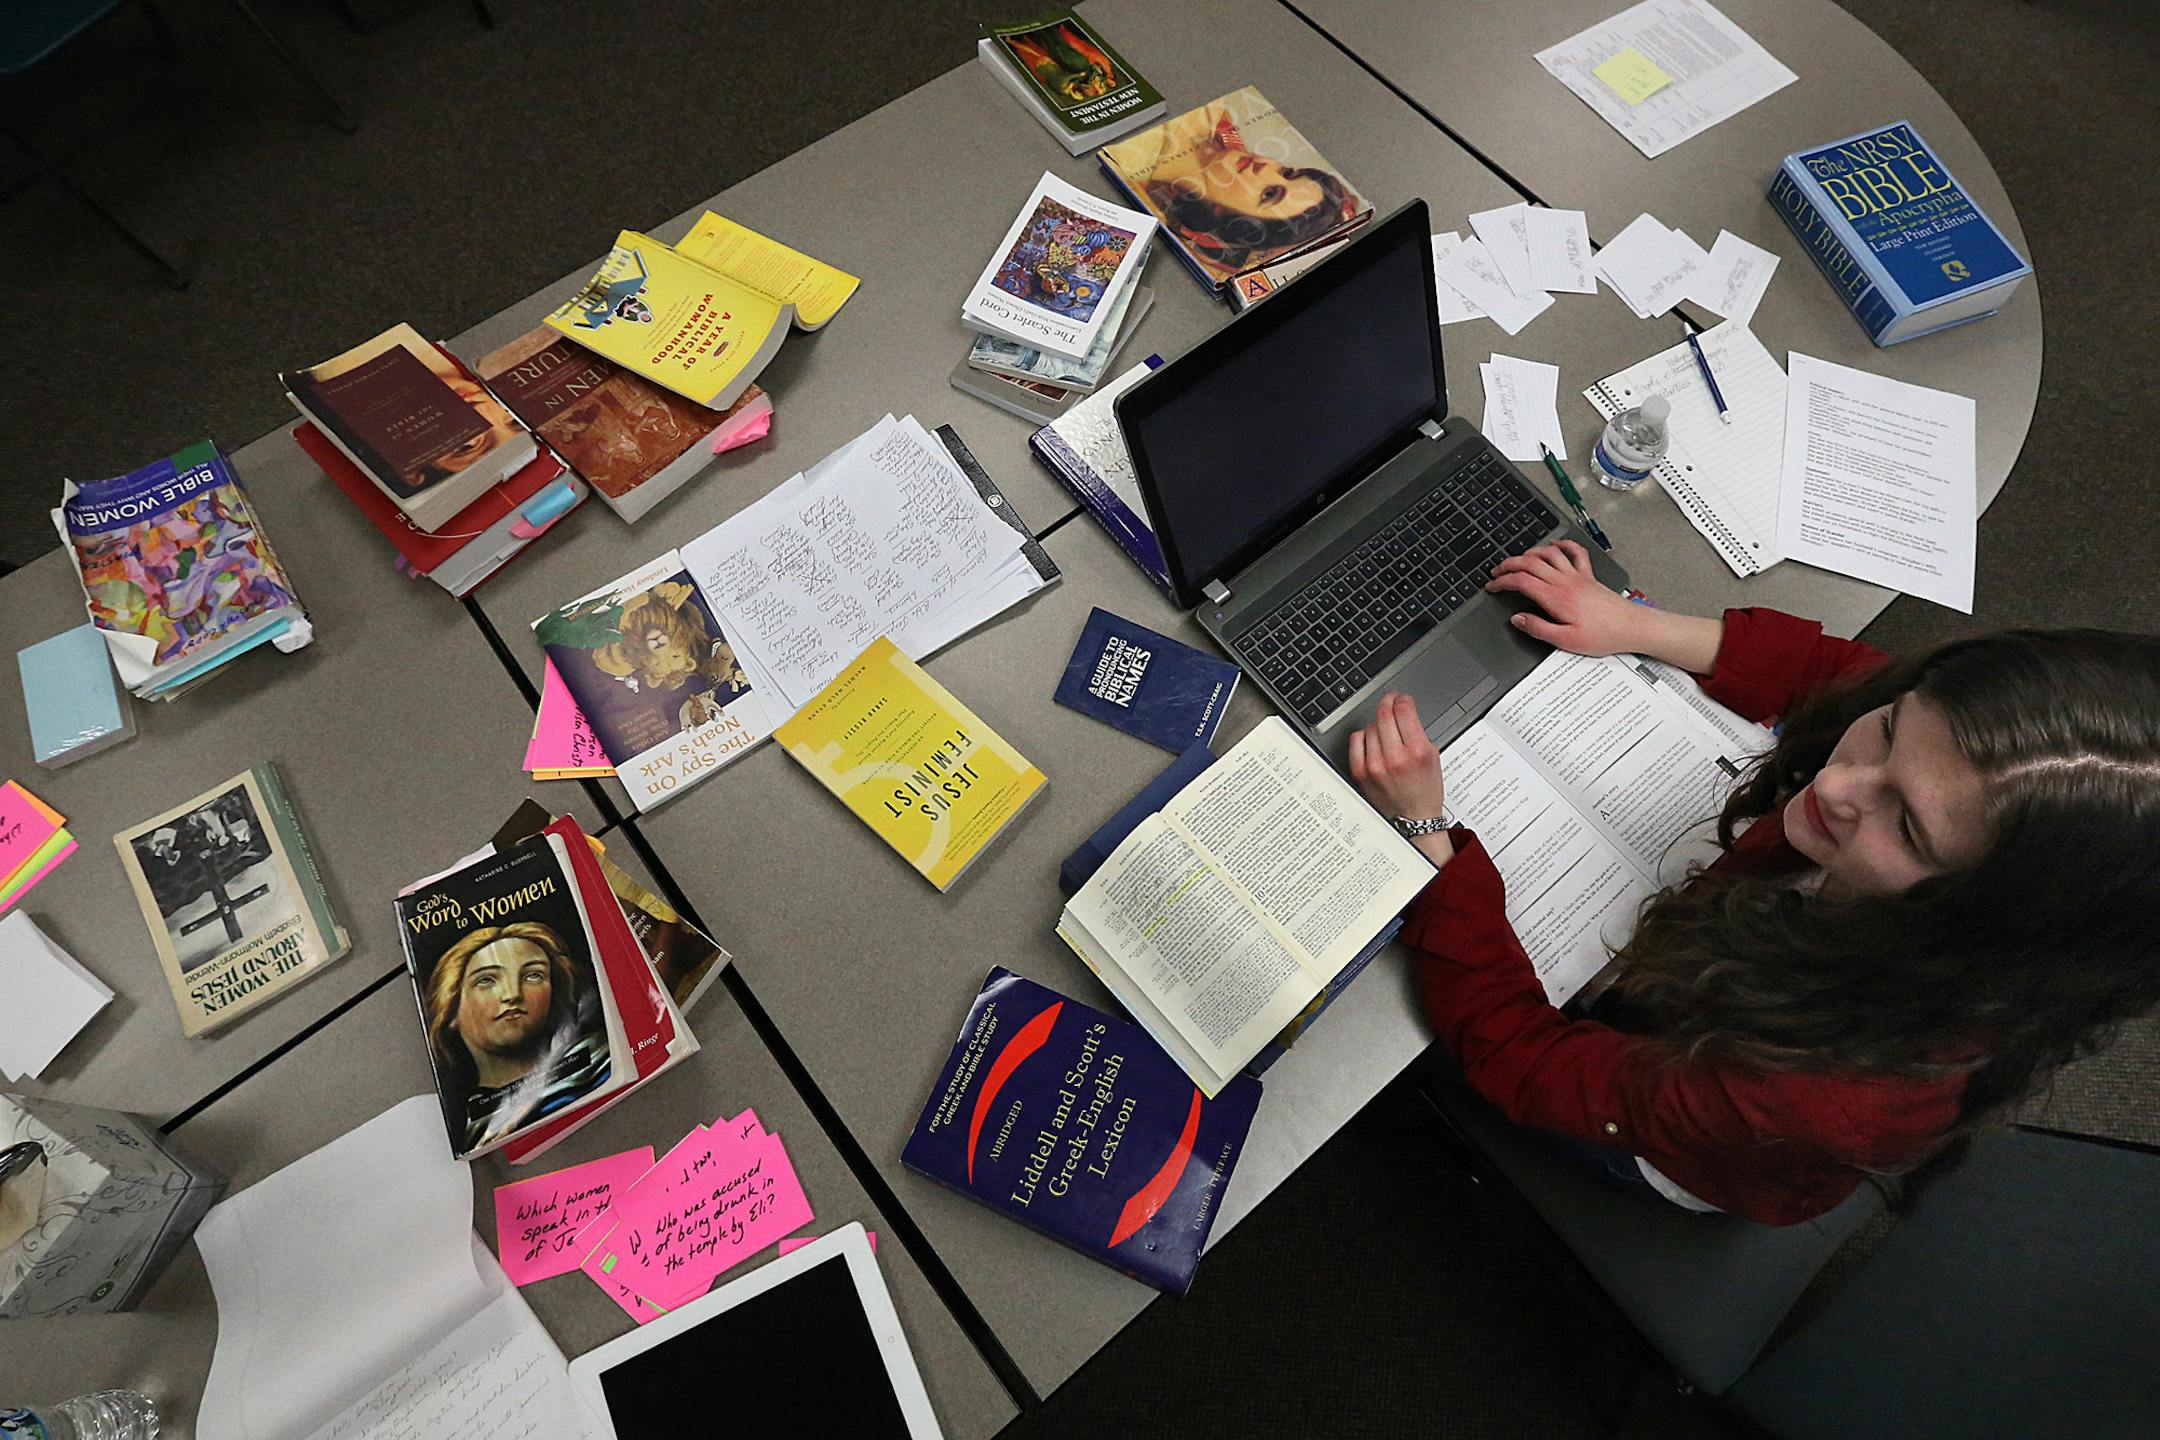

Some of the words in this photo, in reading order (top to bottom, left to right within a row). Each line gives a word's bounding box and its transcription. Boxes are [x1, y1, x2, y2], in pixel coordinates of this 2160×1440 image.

[1070, 95, 1116, 117] TESTAMENT
[1108, 95, 1143, 113] WOMEN
[1114, 86, 1138, 100] NEW
[1079, 112, 1098, 124] THE
[1097, 108, 1109, 118] IN
[1805, 151, 1848, 178] The
[1837, 126, 1916, 170] NRSV
[1819, 149, 1952, 221] BIBLE
[1877, 186, 1963, 227] Apocrypha
[1773, 172, 1821, 233] HOLY
[1812, 226, 1868, 297] BIBLE
[1868, 235, 1905, 253] Large
[1903, 224, 1934, 242] Print
[1933, 209, 1978, 232] Edition
[720, 311, 732, 323] A
[978, 296, 1010, 320] Cord
[1011, 312, 1051, 336] Scarlet
[651, 293, 713, 366] WOMANHOOD
[671, 310, 718, 359] BIBLICAL
[694, 324, 724, 353] YEAR
[1052, 328, 1077, 345] The
[680, 355, 697, 371] OF
[543, 392, 564, 409] IN
[161, 468, 214, 502] BIBLE
[68, 495, 158, 525] WOMEN
[1104, 634, 1120, 653] TO
[1089, 652, 1113, 687] GUIDE
[1094, 637, 1129, 698] PRONOUNCING
[1103, 641, 1140, 703] BIBLICAL
[1113, 646, 1154, 708] NAMES
[866, 696, 888, 718] SARAH
[1086, 684, 1098, 695] A
[1200, 681, 1224, 722] SCOTT-CRAIG
[677, 713, 741, 759] Noah's
[716, 727, 756, 758] The
[842, 716, 867, 741] BESSEY
[638, 751, 676, 780] Ark
[677, 751, 717, 780] Spy
[883, 729, 972, 820] FEMINIST
[644, 772, 678, 798] On
[919, 762, 979, 823] JESUS
[474, 865, 504, 883] KATHARINE
[510, 850, 537, 867] BUSHNELL
[407, 899, 464, 934] Word
[414, 890, 449, 914] God's
[467, 874, 557, 925] Women
[262, 912, 301, 941] Elisabeth
[454, 916, 470, 930] to
[183, 935, 264, 986] Moltmann-Wendel
[240, 926, 308, 976] AROUND
[271, 947, 307, 977] THE
[188, 965, 239, 1004] JESUS
[200, 971, 270, 1016] WOMEN
[636, 1030, 660, 1050] Ringe
[928, 1112, 943, 1133] FOR
[937, 1092, 952, 1112] THE
[947, 1062, 966, 1093] STUDY
[961, 1049, 973, 1063] OF
[967, 1000, 996, 1050] CLASSICAL
[942, 1092, 964, 1125] GREEK
[958, 1071, 973, 1093] AND
[967, 1044, 986, 1072] BIBLE
[980, 1015, 1000, 1045] STUDY
[987, 1099, 1024, 1162] ABRIDGED
[1009, 1128, 1059, 1207] Liddell
[1049, 1088, 1077, 1130] and
[1063, 1019, 1108, 1089] Scott's
[1045, 1056, 1125, 1199] Greek-English
[1087, 1095, 1138, 1179] Lexicon
[515, 1189, 557, 1221] Which
[563, 1182, 611, 1206] women
[653, 1212, 677, 1235] Who
[681, 1197, 709, 1219] was
[710, 1157, 762, 1201] accused
[1192, 1192, 1213, 1230] LARGER
[1208, 1141, 1233, 1187] TYPEFACE
[519, 1209, 568, 1242] speak
[572, 1207, 591, 1222] in
[654, 1232, 671, 1255] of
[673, 1216, 710, 1242] being
[712, 1182, 759, 1219] drunk
[760, 1175, 775, 1189] in
[523, 1239, 545, 1261] of
[662, 1253, 685, 1275] the
[686, 1224, 729, 1259] temple
[726, 1217, 748, 1244] by
[744, 1192, 777, 1222] Eli?
